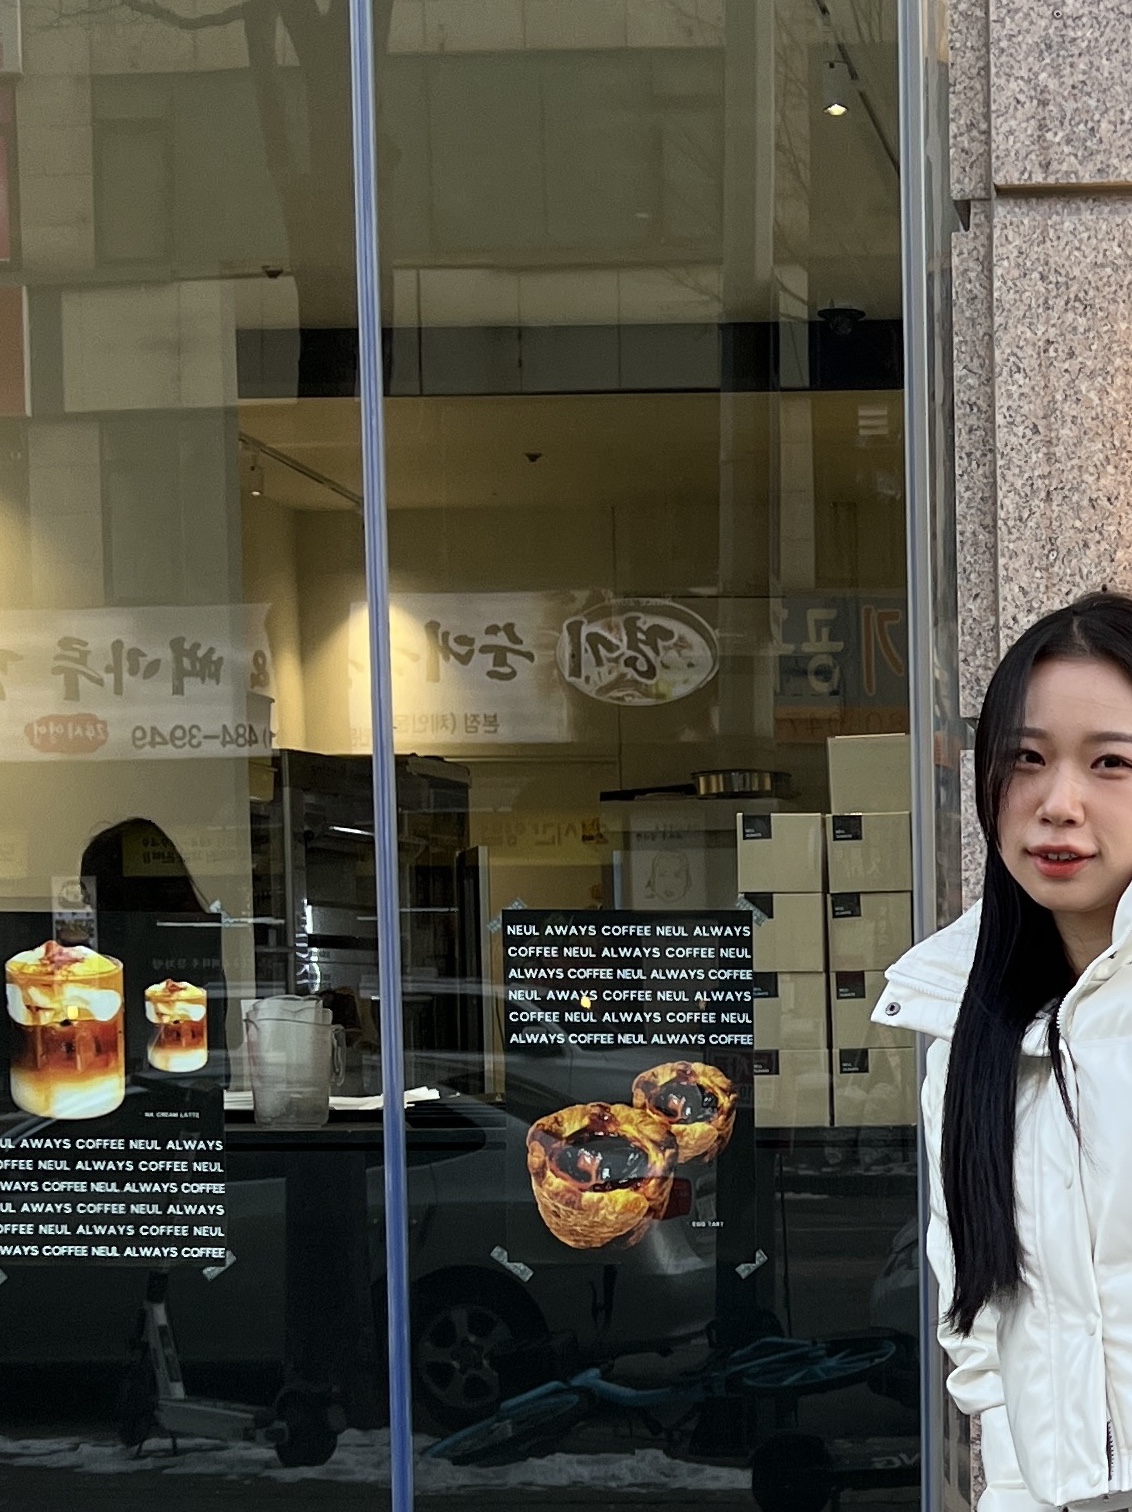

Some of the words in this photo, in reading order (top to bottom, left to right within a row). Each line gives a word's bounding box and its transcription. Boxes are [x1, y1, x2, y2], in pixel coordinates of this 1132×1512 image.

[507, 925, 539, 935] NEUL
[545, 925, 596, 935] AWAYS
[602, 926, 651, 936] COFFEE
[656, 926, 688, 936] NEUL
[693, 926, 750, 936] ALWAYS
[508, 947, 558, 957] COFFEE
[564, 947, 596, 957] NEUL
[602, 947, 660, 957] ALWAYS
[666, 948, 715, 958] COFFEE
[720, 948, 751, 958] NEUL
[509, 968, 564, 979] ALWAYS
[568, 969, 613, 979] COFFEE
[617, 969, 646, 979] NEUL
[651, 969, 704, 979] ALWAYS
[708, 969, 752, 979] COFFEE
[509, 990, 541, 1000] NEUL
[547, 990, 597, 1001] AWAYS
[603, 990, 652, 1001] COFFEE
[657, 991, 689, 1001] NEUL
[694, 991, 751, 1001] ALWAYS
[509, 1012, 559, 1022] COFFEE
[565, 1012, 597, 1022] NEUL
[602, 1012, 661, 1022] ALWAYS
[666, 1012, 716, 1023] COFFEE
[721, 1013, 752, 1023] NEUL
[510, 1033, 565, 1043] ALWAYS
[568, 1034, 614, 1044] COFFEE
[618, 1033, 647, 1044] NEUL
[651, 1034, 705, 1044] ALWAYS
[709, 1034, 753, 1044] COFFEE
[20, 1139, 71, 1149] AWAYS
[76, 1139, 124, 1149] COFFEE
[130, 1140, 161, 1150] NEUL
[167, 1140, 223, 1150] ALWAYS
[0, 1160, 33, 1170] FFEE
[38, 1160, 70, 1170] NEUL
[76, 1161, 133, 1171] ALWAYS
[139, 1161, 188, 1171] COFFEE
[193, 1162, 223, 1172] NEUL
[42, 1182, 87, 1192] COFFEE
[91, 1182, 120, 1192] NEUL
[123, 1182, 178, 1193] ALWAYS
[181, 1183, 225, 1193] COFFEE
[21, 1203, 72, 1213] AWAYS
[77, 1203, 126, 1214] COFFEE
[131, 1204, 162, 1214] NEUL
[167, 1205, 224, 1215] ALWAYS
[0, 1224, 34, 1234] FFEE
[39, 1224, 71, 1234] NEUL
[76, 1225, 134, 1235] ALWAYS
[140, 1226, 188, 1236] COFFEE
[194, 1226, 225, 1236] NEUL
[42, 1246, 88, 1256] COFFEE
[92, 1246, 120, 1256] NEUL
[124, 1247, 178, 1257] ALWAYS
[181, 1248, 225, 1258] COFFEE
